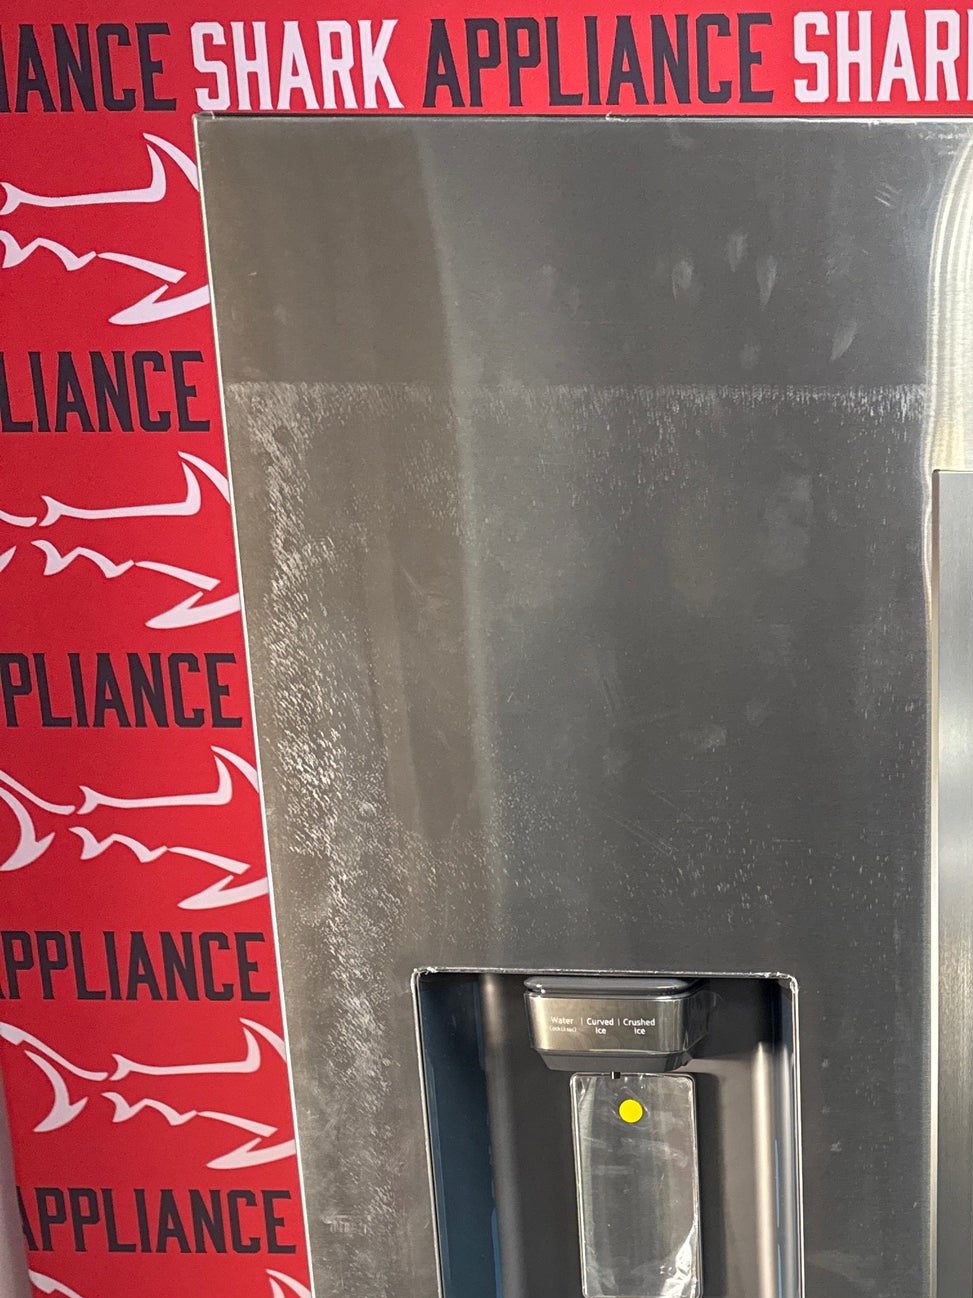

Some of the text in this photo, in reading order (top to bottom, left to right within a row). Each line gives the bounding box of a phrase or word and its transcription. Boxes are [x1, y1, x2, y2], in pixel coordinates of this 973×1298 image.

[191, 20, 404, 110] SHARK
[423, 13, 773, 107] APPLIANCE
[0, 653, 242, 727] PLIANCE
[0, 930, 270, 1001] PPLIANCE
[550, 1016, 656, 1027] Water Curved Crushed
[595, 1027, 607, 1035] Ice
[633, 1027, 646, 1035] Ice
